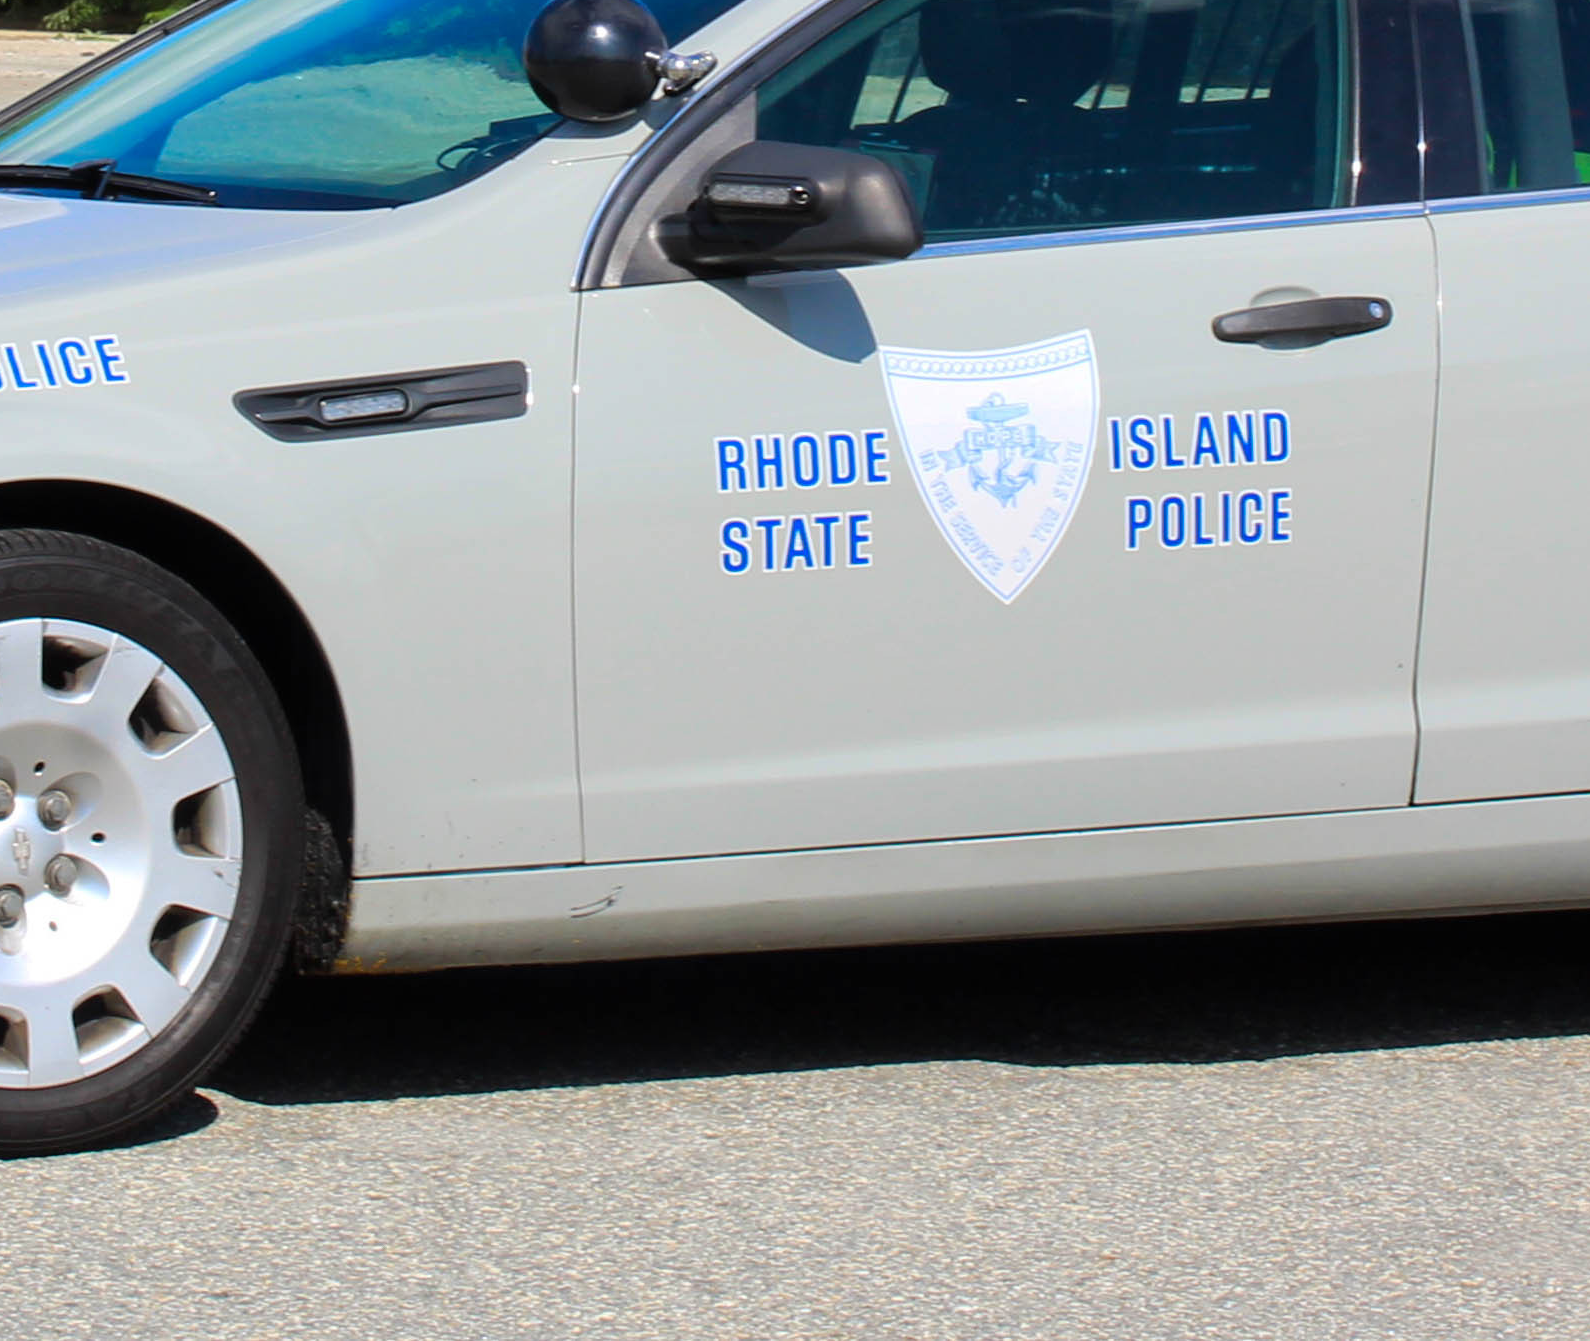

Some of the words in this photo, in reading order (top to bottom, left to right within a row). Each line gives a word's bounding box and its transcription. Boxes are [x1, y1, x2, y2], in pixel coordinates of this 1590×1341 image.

[716, 431, 890, 492] RHODE
[1110, 412, 1291, 471] ISLAND
[722, 513, 872, 575] STATE
[1127, 491, 1292, 550] POLICE
